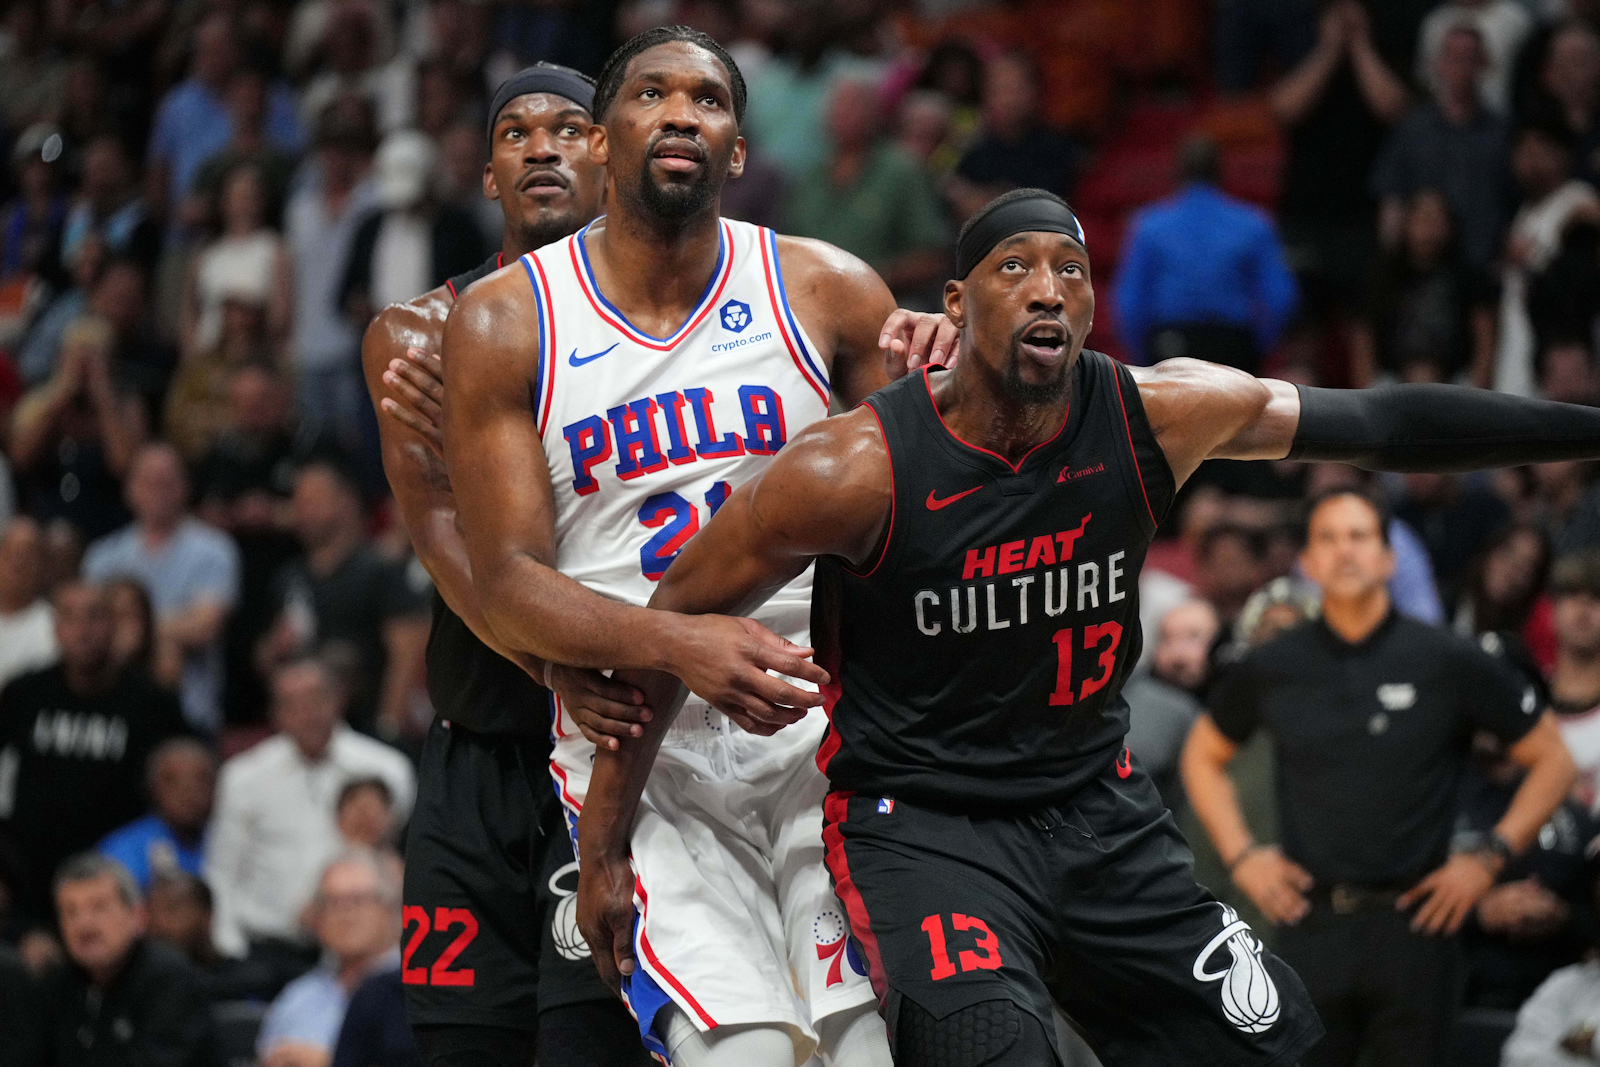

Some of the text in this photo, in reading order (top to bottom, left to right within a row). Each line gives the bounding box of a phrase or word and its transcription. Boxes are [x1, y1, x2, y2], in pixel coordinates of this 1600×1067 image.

[711, 331, 772, 352] crypto.com
[562, 384, 787, 497] PHILA
[1064, 462, 1105, 480] Carnival
[962, 512, 1092, 580] HEAT
[914, 550, 1126, 636] CULTURE
[1049, 620, 1123, 706] 13
[402, 904, 479, 987] 22
[920, 912, 1004, 981] 13
